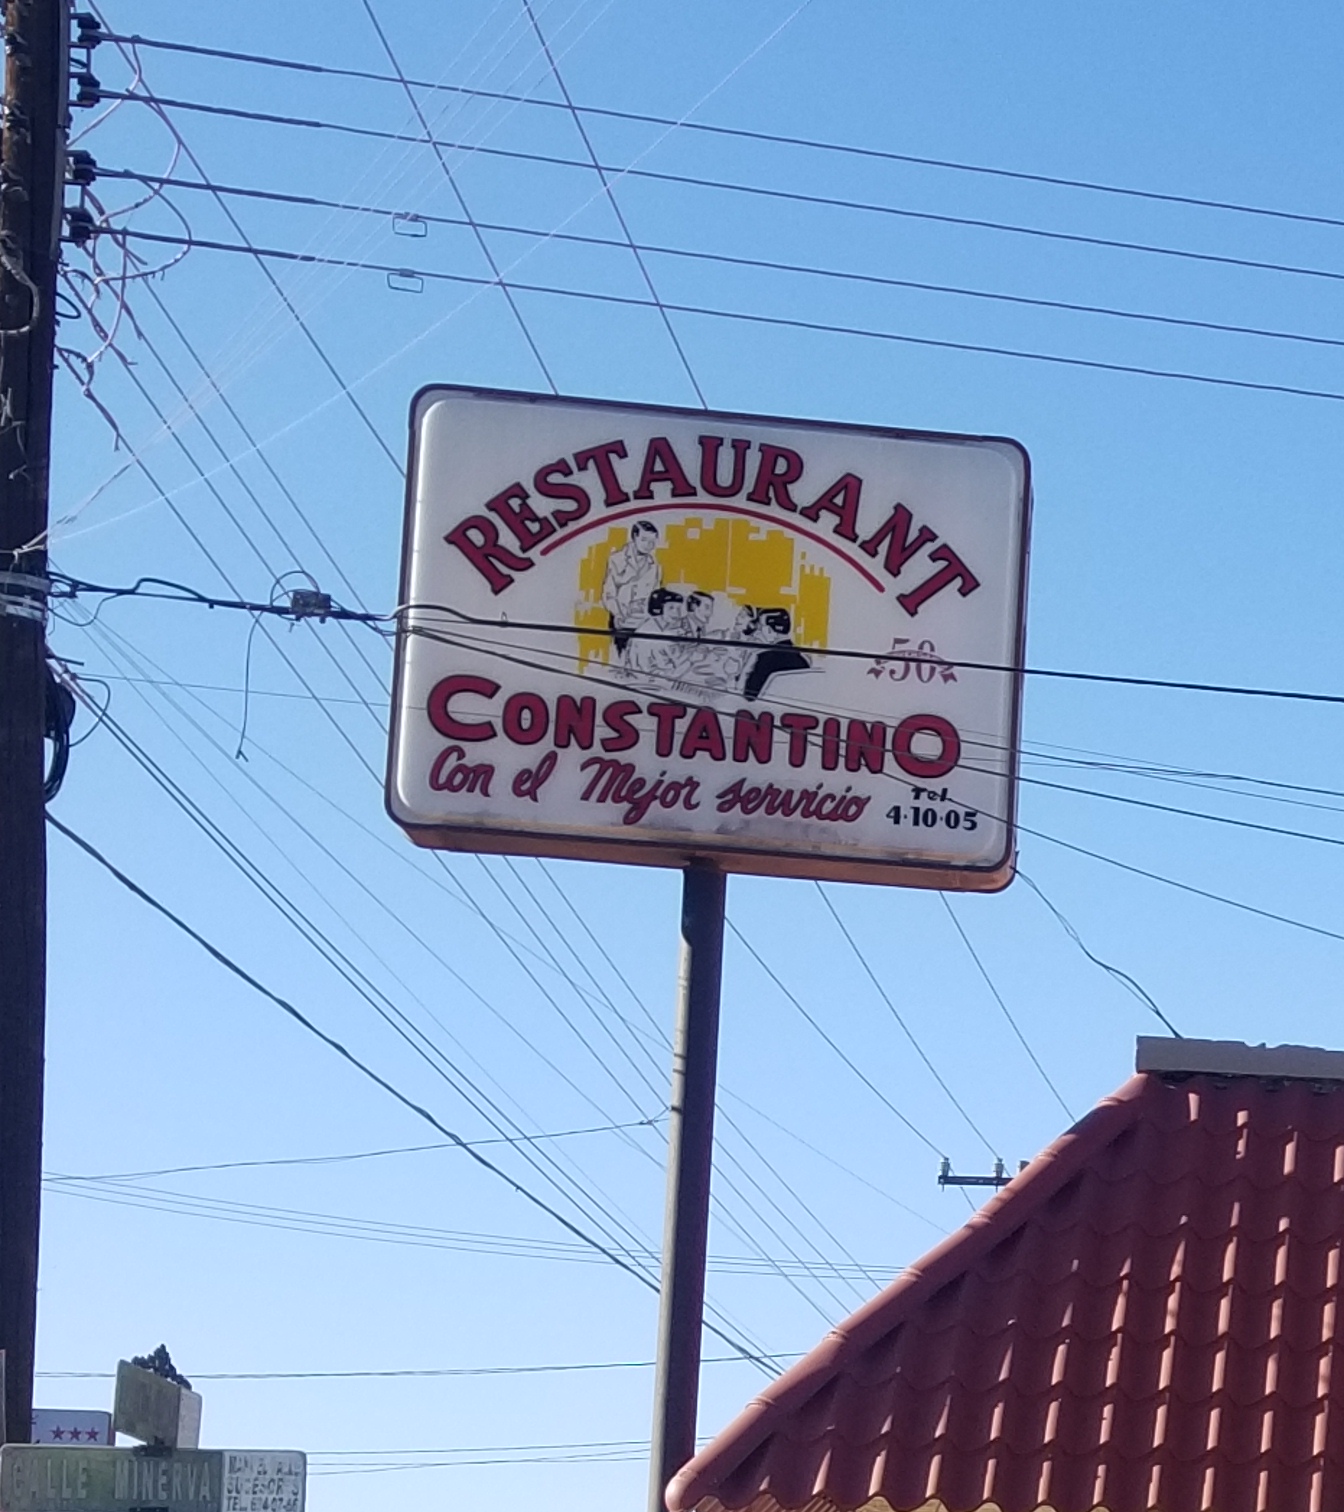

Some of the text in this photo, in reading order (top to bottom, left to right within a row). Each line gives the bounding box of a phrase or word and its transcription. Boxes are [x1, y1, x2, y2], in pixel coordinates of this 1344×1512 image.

[444, 436, 981, 618] RESTAURANT
[427, 675, 962, 778] CONSTANTINO
[430, 746, 872, 826] Con el Mejor servicio
[11, 1457, 211, 1501] CALLE MINERVA
